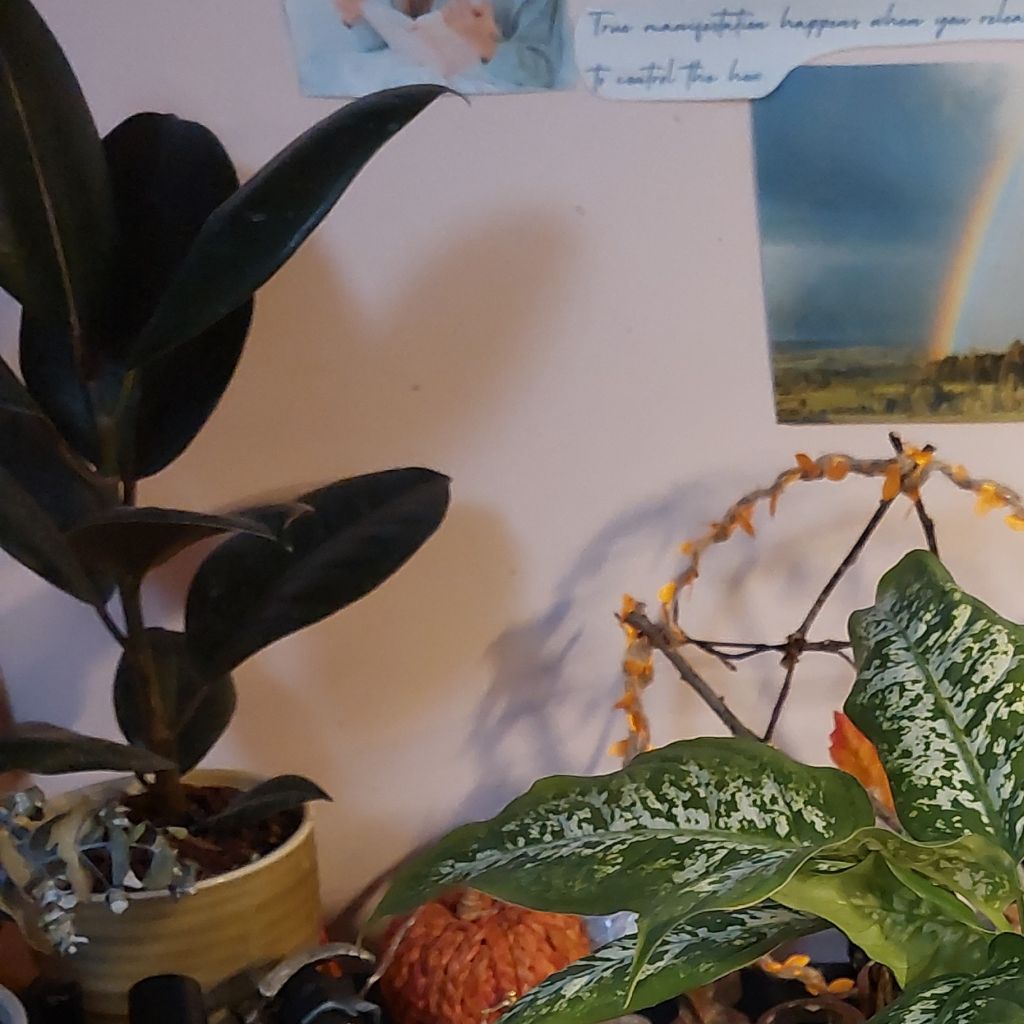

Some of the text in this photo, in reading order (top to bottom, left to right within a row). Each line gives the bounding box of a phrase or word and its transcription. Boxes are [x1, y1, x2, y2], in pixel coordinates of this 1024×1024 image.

[588, 10, 632, 36] True
[780, 6, 860, 38] happens
[934, 15, 970, 38] you
[616, 59, 675, 90] control
